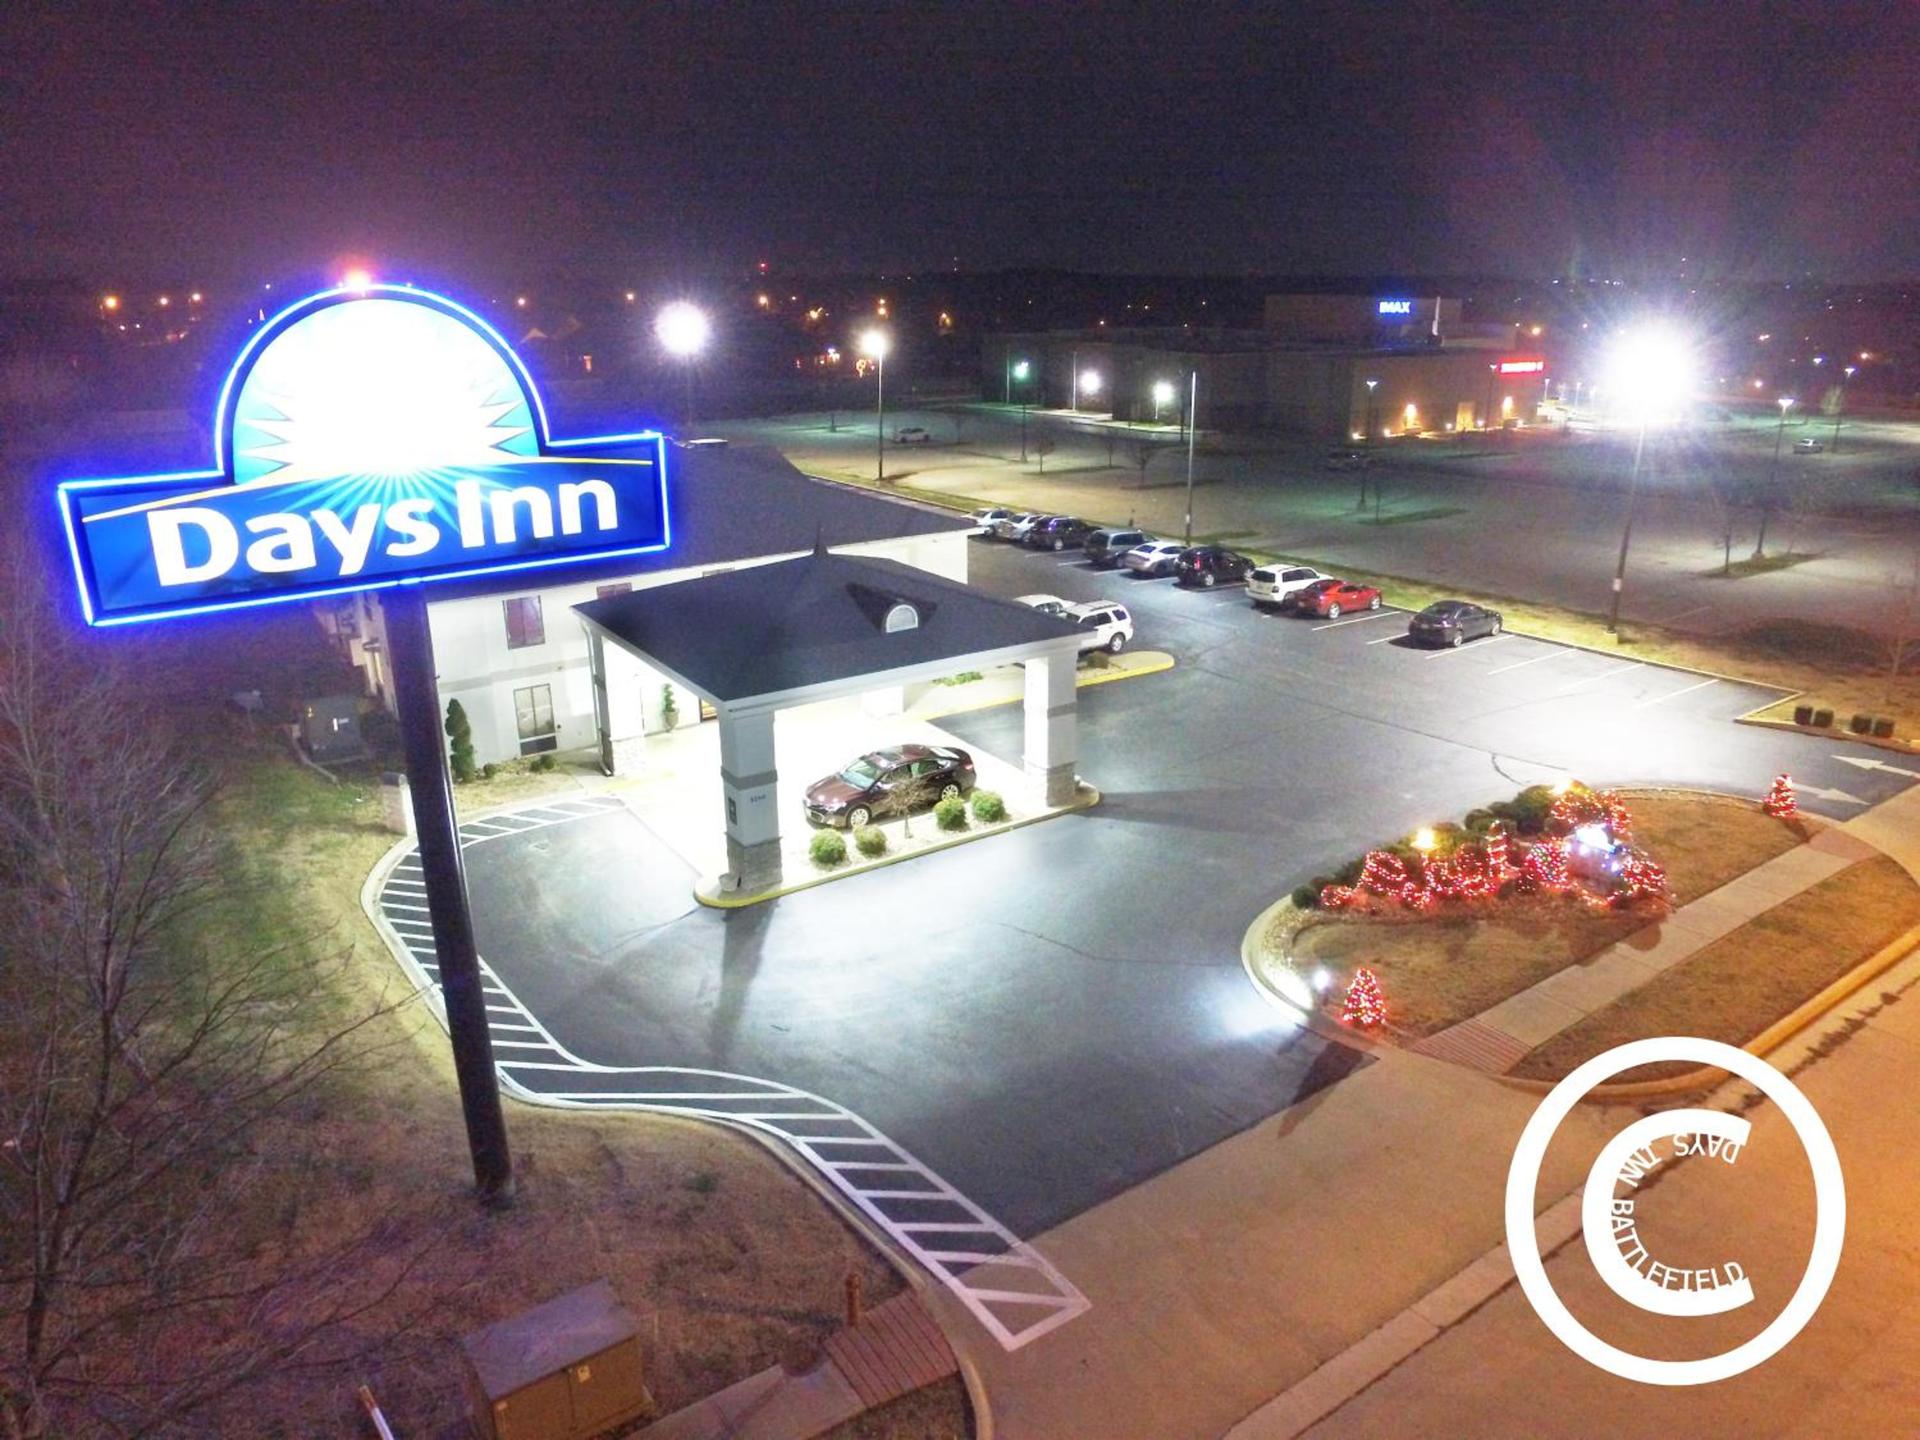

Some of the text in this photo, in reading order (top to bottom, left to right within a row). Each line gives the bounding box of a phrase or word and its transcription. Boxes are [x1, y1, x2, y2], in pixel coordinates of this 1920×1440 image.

[1379, 301, 1410, 313] IMAX
[147, 478, 619, 587] Days Inn
